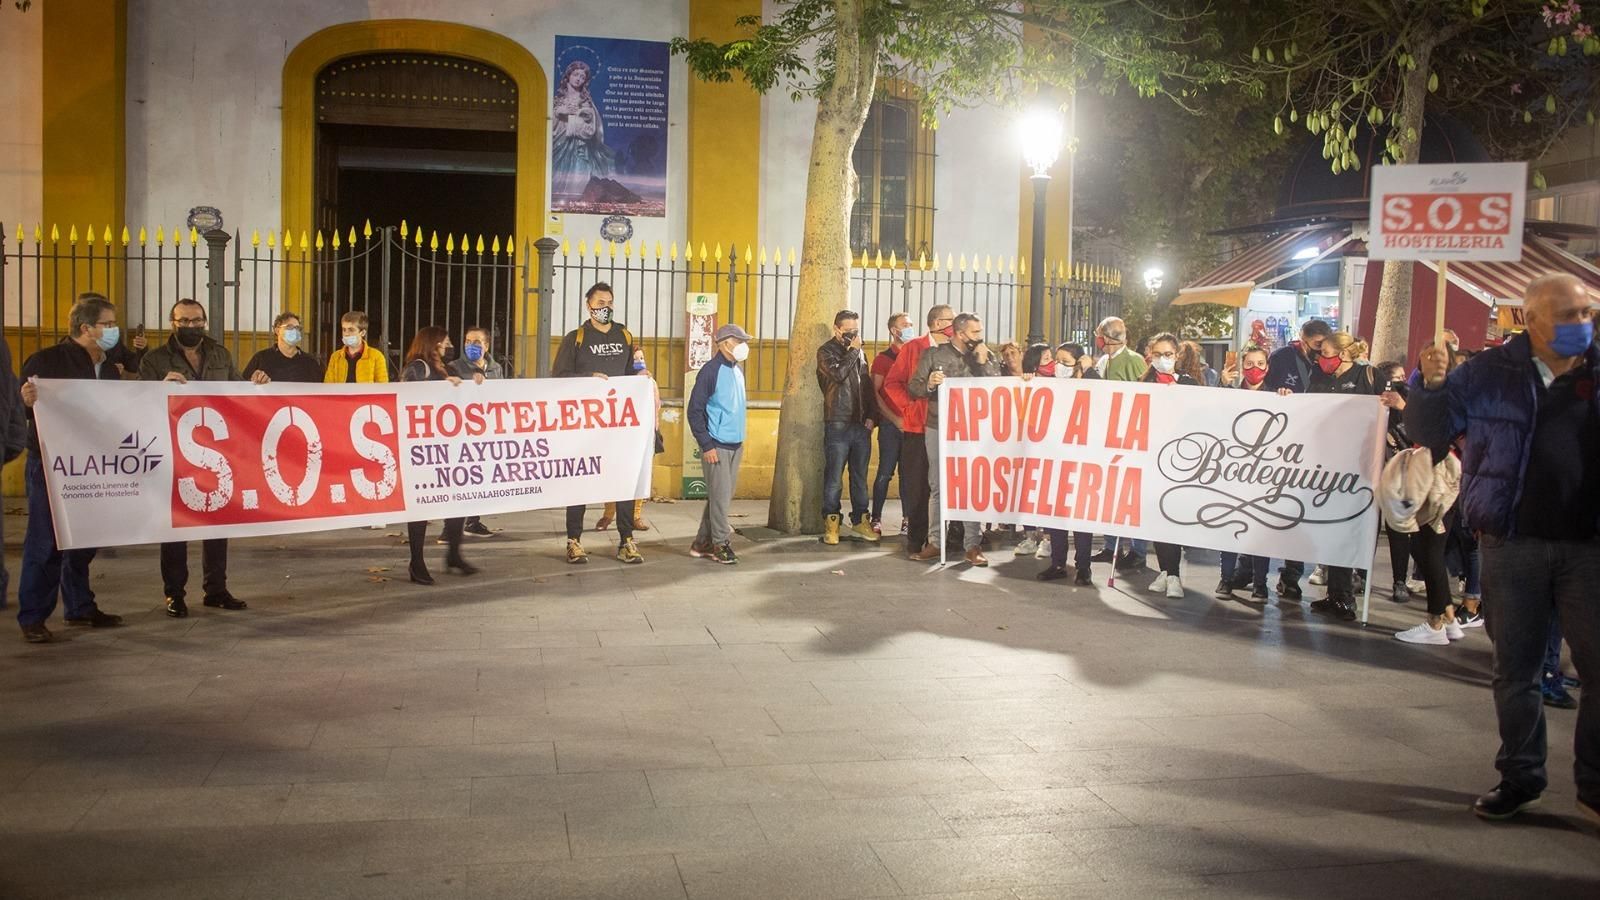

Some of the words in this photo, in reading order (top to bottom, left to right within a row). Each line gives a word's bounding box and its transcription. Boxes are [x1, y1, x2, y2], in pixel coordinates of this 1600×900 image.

[1383, 196, 1509, 231] S.O.S
[1511, 307, 1526, 326] KI
[405, 388, 640, 439] HOSTELERÍA
[946, 386, 1054, 442] APOYO
[1062, 390, 1091, 446] A
[1104, 392, 1151, 452] LA
[410, 444, 449, 466] SIN
[458, 438, 550, 463] AYUDAS
[1227, 408, 1304, 464] La
[53, 455, 140, 476] ALAHO
[177, 404, 398, 512] S.O.S
[414, 464, 484, 490] ...NOS
[491, 456, 602, 484] ARRUINAN
[1158, 432, 1373, 508] Bodeguiya
[62, 482, 101, 491] Asociación
[102, 482, 128, 490] Linense
[94, 490, 103, 498] de
[416, 494, 449, 504] #ALAHO
[946, 454, 1142, 528] HOSTELERÍA
